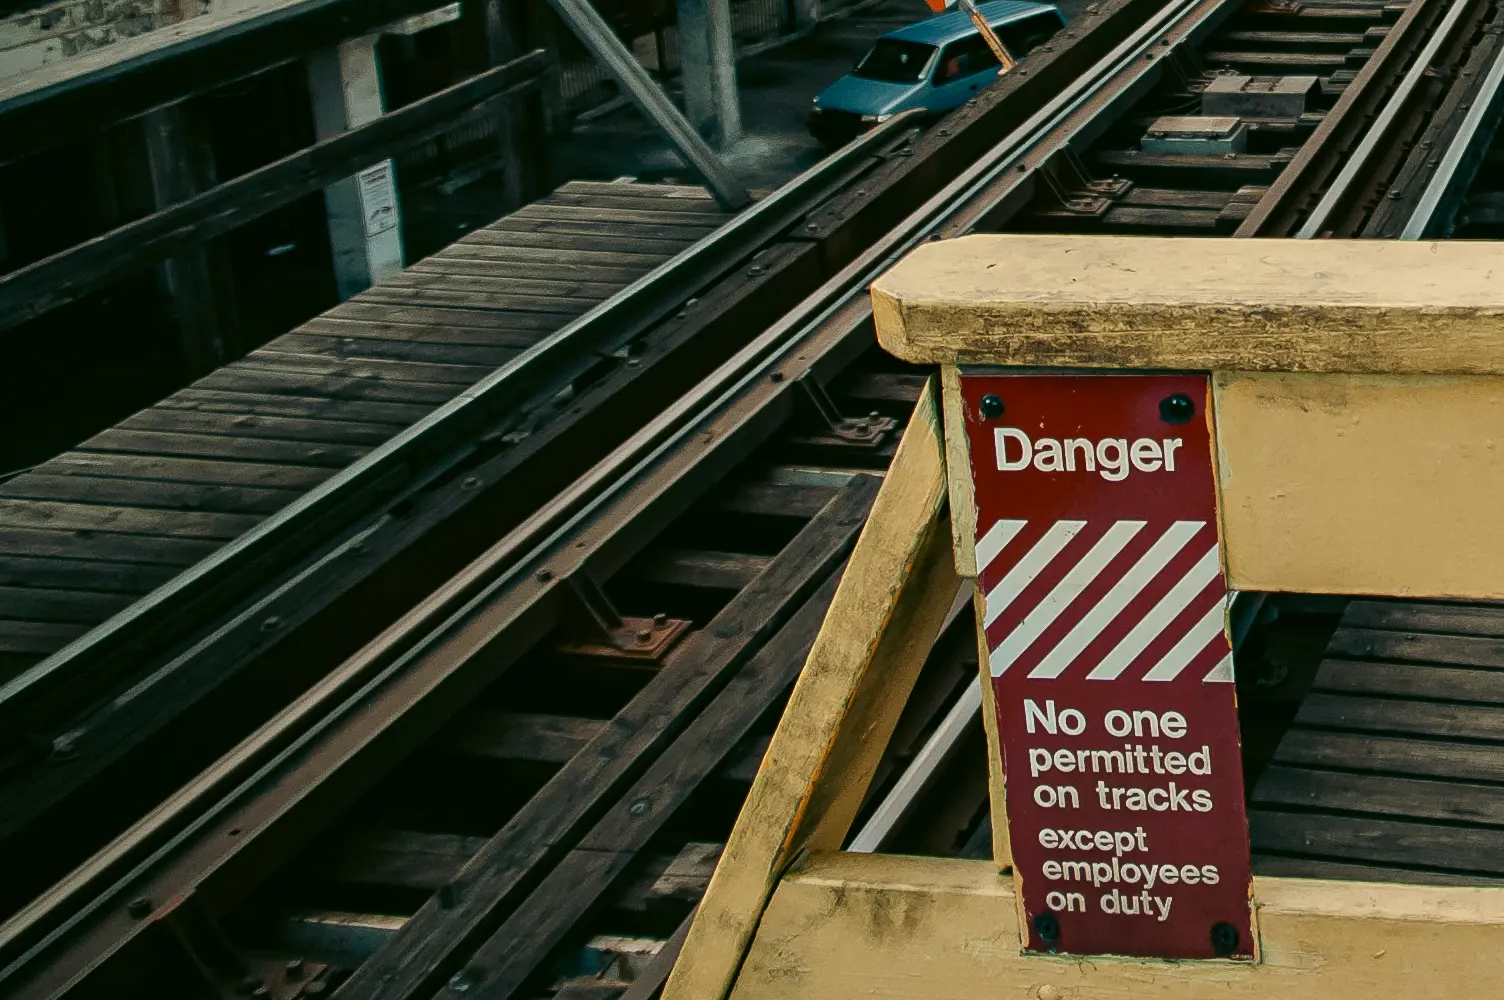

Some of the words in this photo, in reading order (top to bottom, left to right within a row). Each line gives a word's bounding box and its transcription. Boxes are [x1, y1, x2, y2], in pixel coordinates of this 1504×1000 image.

[993, 427, 1183, 482] Danger
[1023, 698, 1086, 736] No
[1104, 708, 1188, 739] one
[1029, 743, 1212, 778] permitted
[1033, 784, 1080, 809] on
[1095, 780, 1213, 813] tracks
[1038, 826, 1148, 857] except
[1042, 857, 1220, 889] employees
[1045, 890, 1086, 913] on
[1100, 888, 1173, 921] duty
